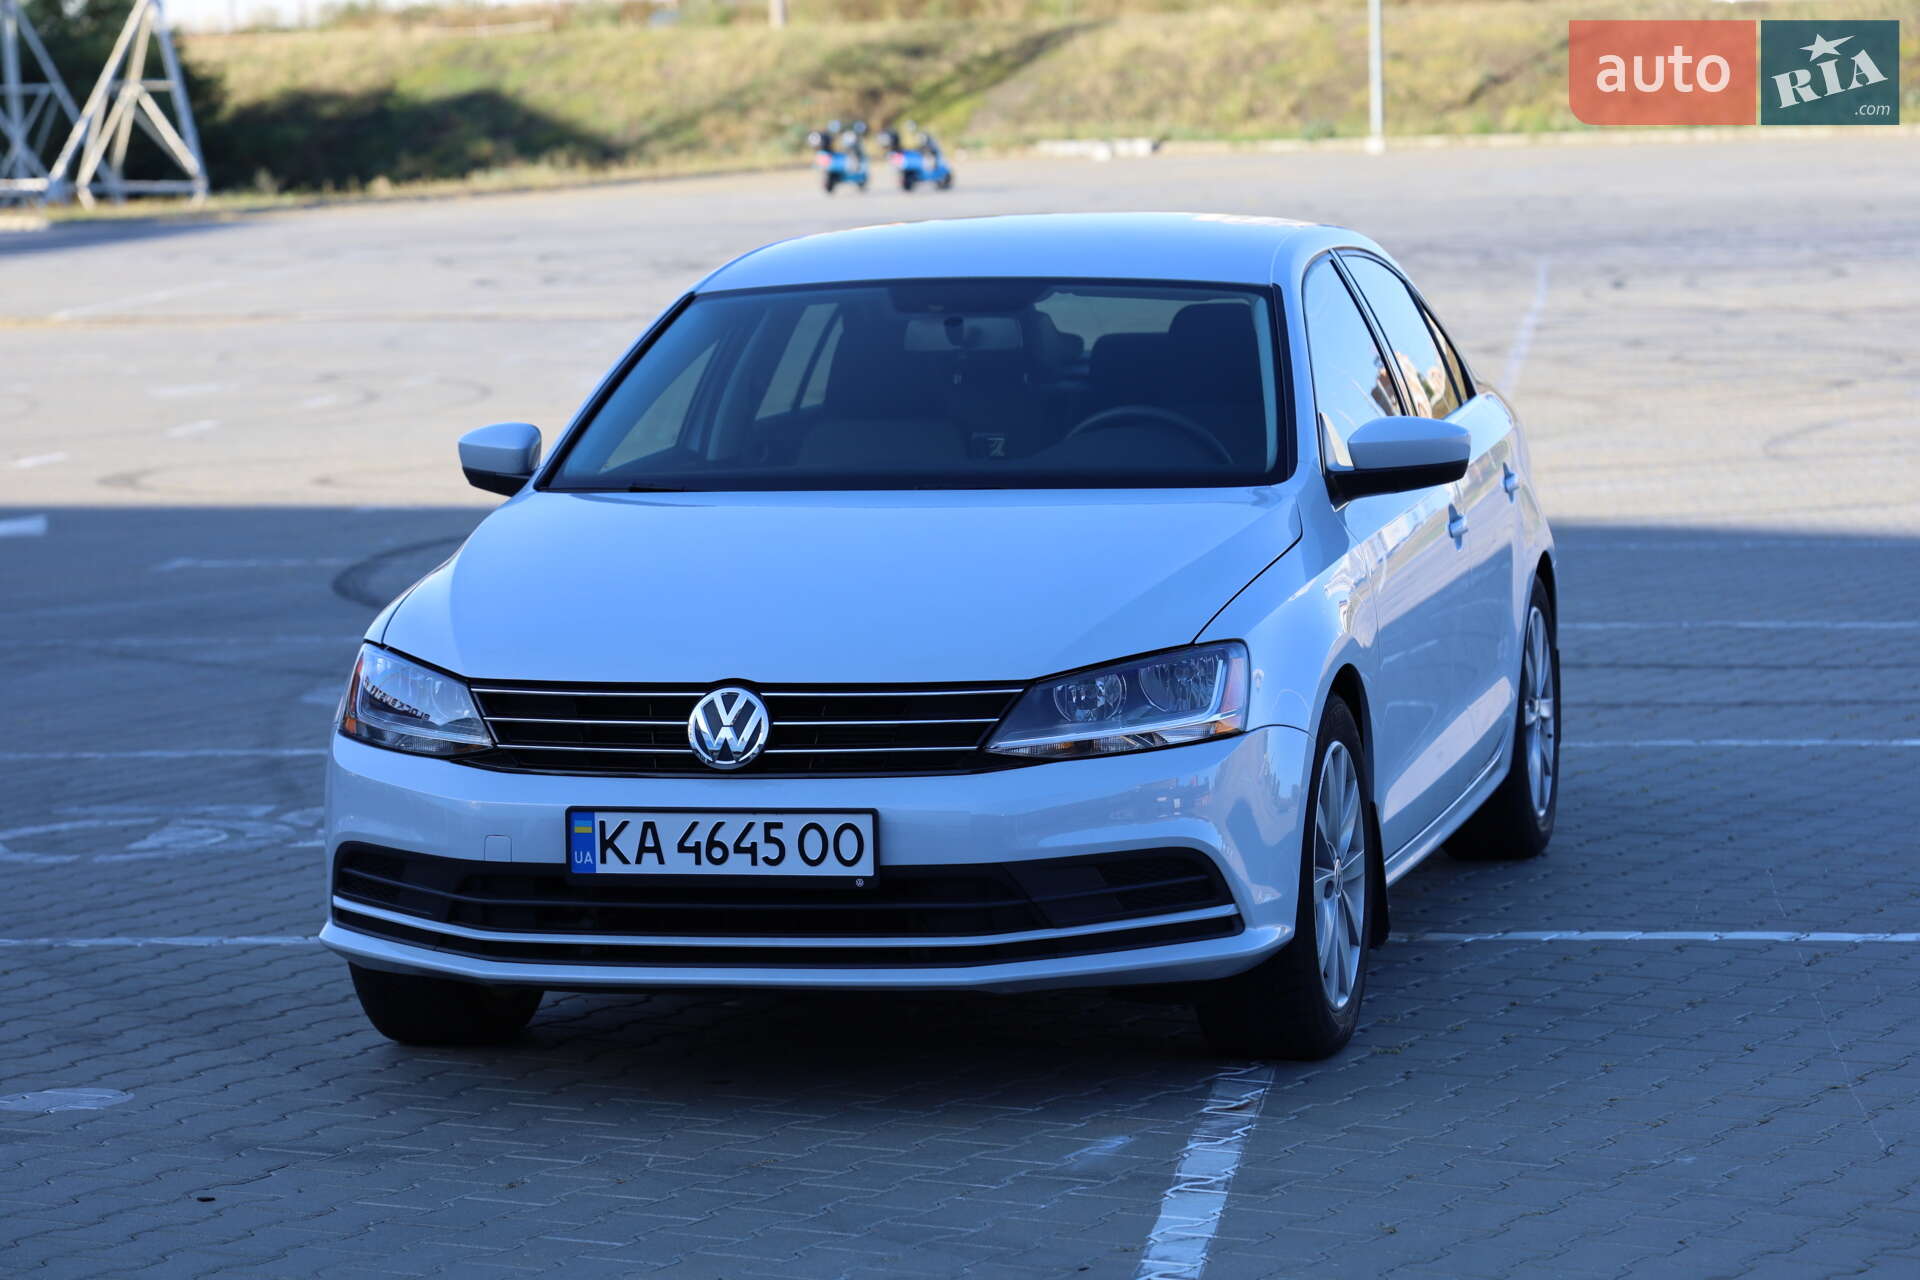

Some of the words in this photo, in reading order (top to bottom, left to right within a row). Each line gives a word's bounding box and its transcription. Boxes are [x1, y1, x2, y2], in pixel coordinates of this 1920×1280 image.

[573, 850, 594, 865] UA
[598, 820, 666, 865] KA
[676, 821, 786, 867] 4645
